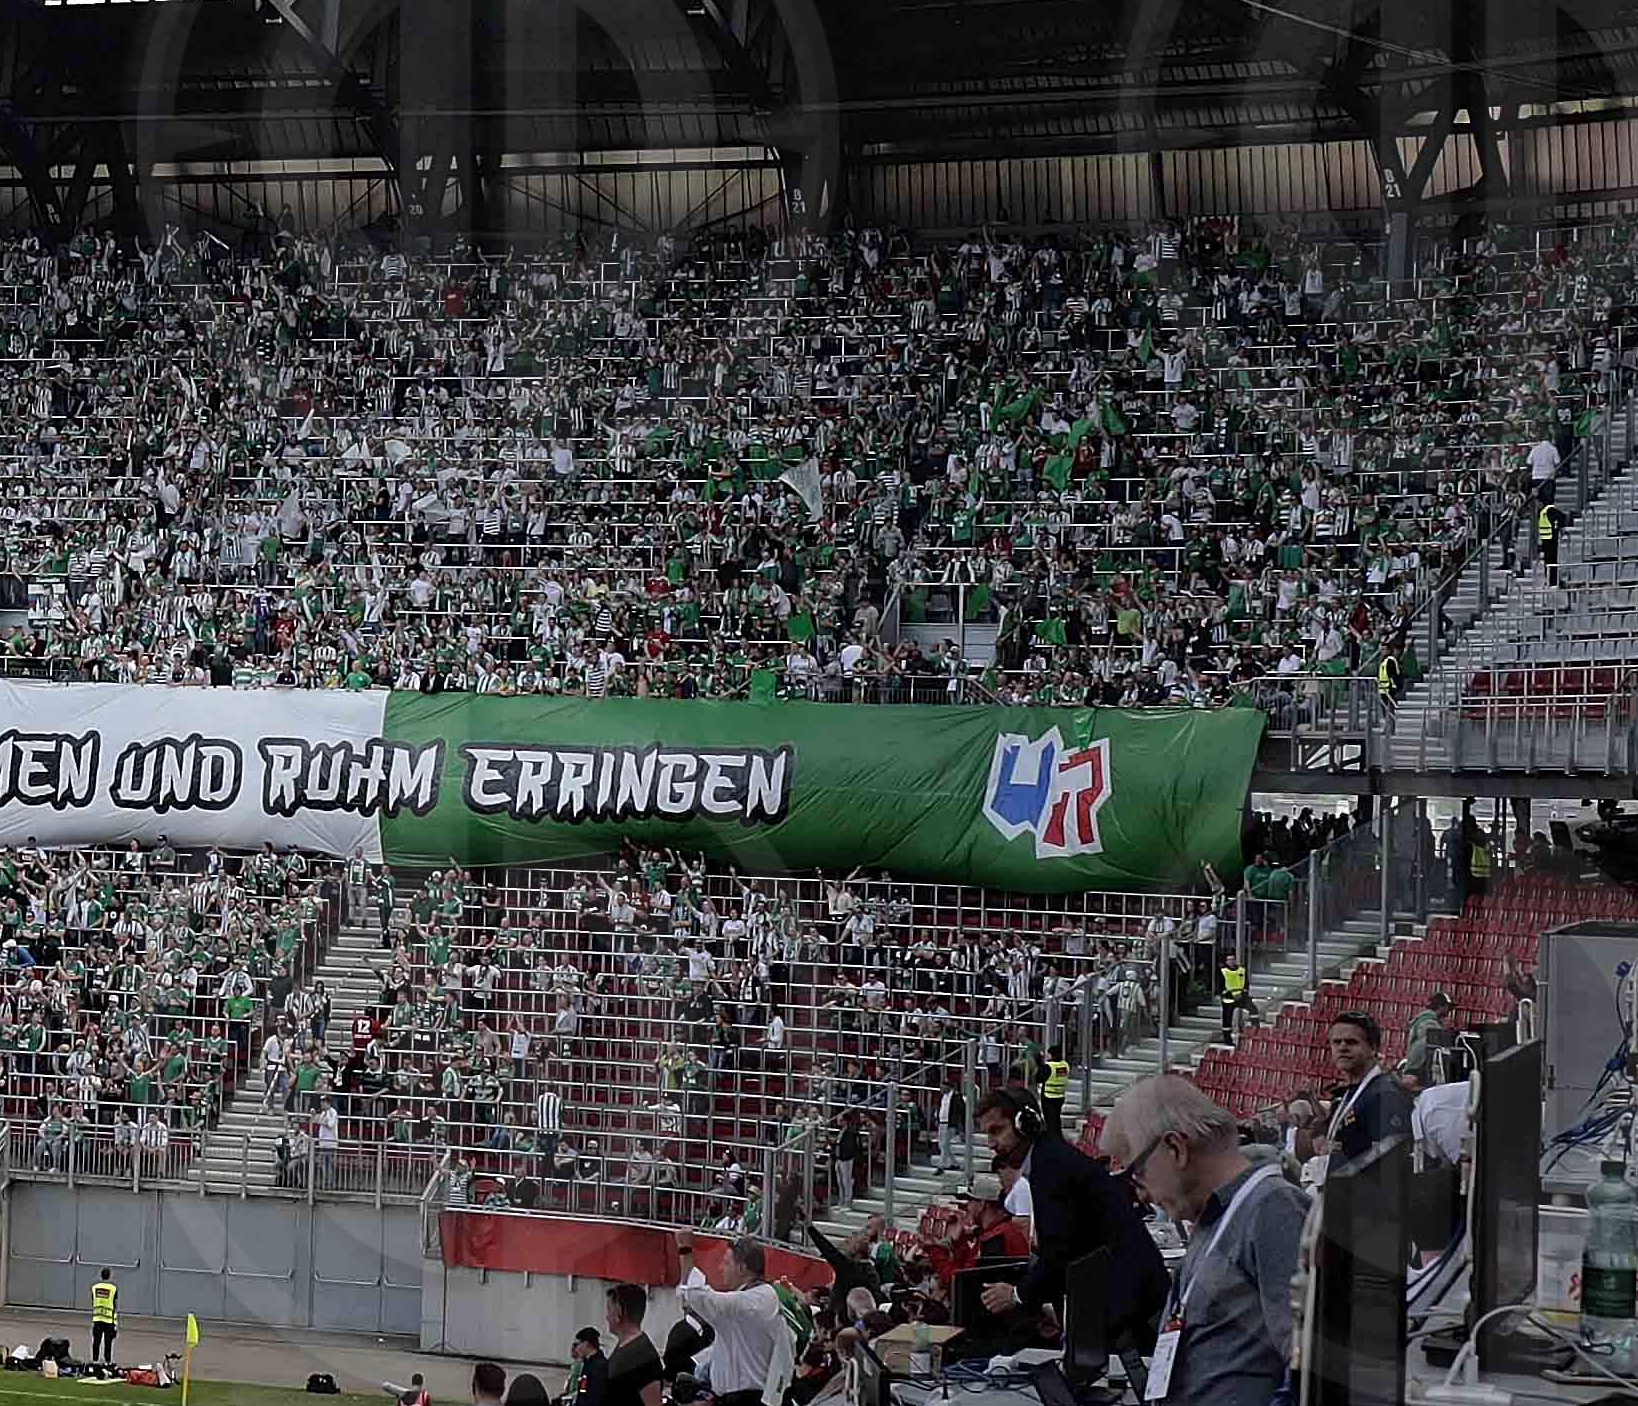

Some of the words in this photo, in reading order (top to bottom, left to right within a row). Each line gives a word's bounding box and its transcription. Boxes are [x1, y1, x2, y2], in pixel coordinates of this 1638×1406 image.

[1385, 183, 1402, 198] 21
[792, 201, 806, 213] 21
[112, 733, 241, 813] UND
[262, 735, 444, 817] RUHM
[462, 740, 791, 822] ERRINGEN
